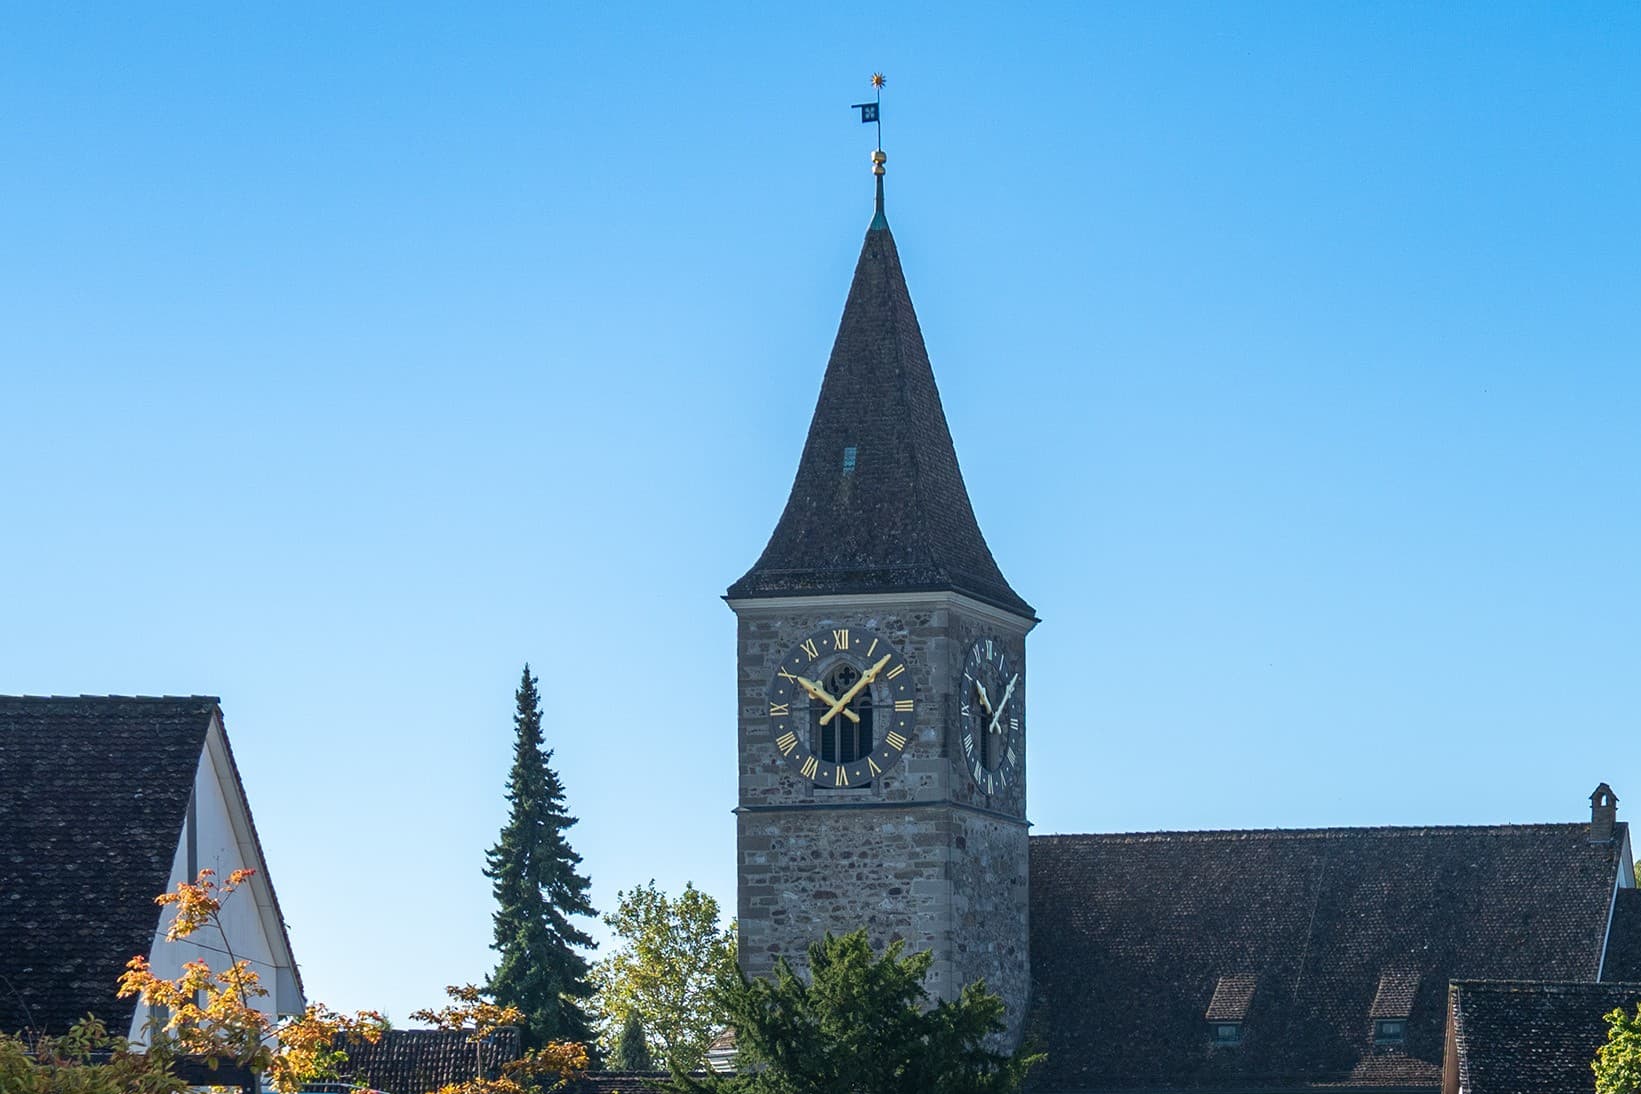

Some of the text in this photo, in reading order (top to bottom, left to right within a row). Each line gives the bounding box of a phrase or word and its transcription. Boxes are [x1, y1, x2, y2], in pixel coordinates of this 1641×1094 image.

[800, 638, 818, 661] XI
[833, 629, 848, 650] XII
[867, 638, 878, 656] I
[778, 666, 797, 684] X
[886, 664, 905, 680] II
[770, 702, 788, 715] IX
[895, 700, 913, 712] III
[776, 731, 798, 756] VIII
[886, 731, 906, 751] IIII
[800, 756, 818, 780] VII
[836, 765, 848, 786] VI
[867, 757, 882, 777] V
